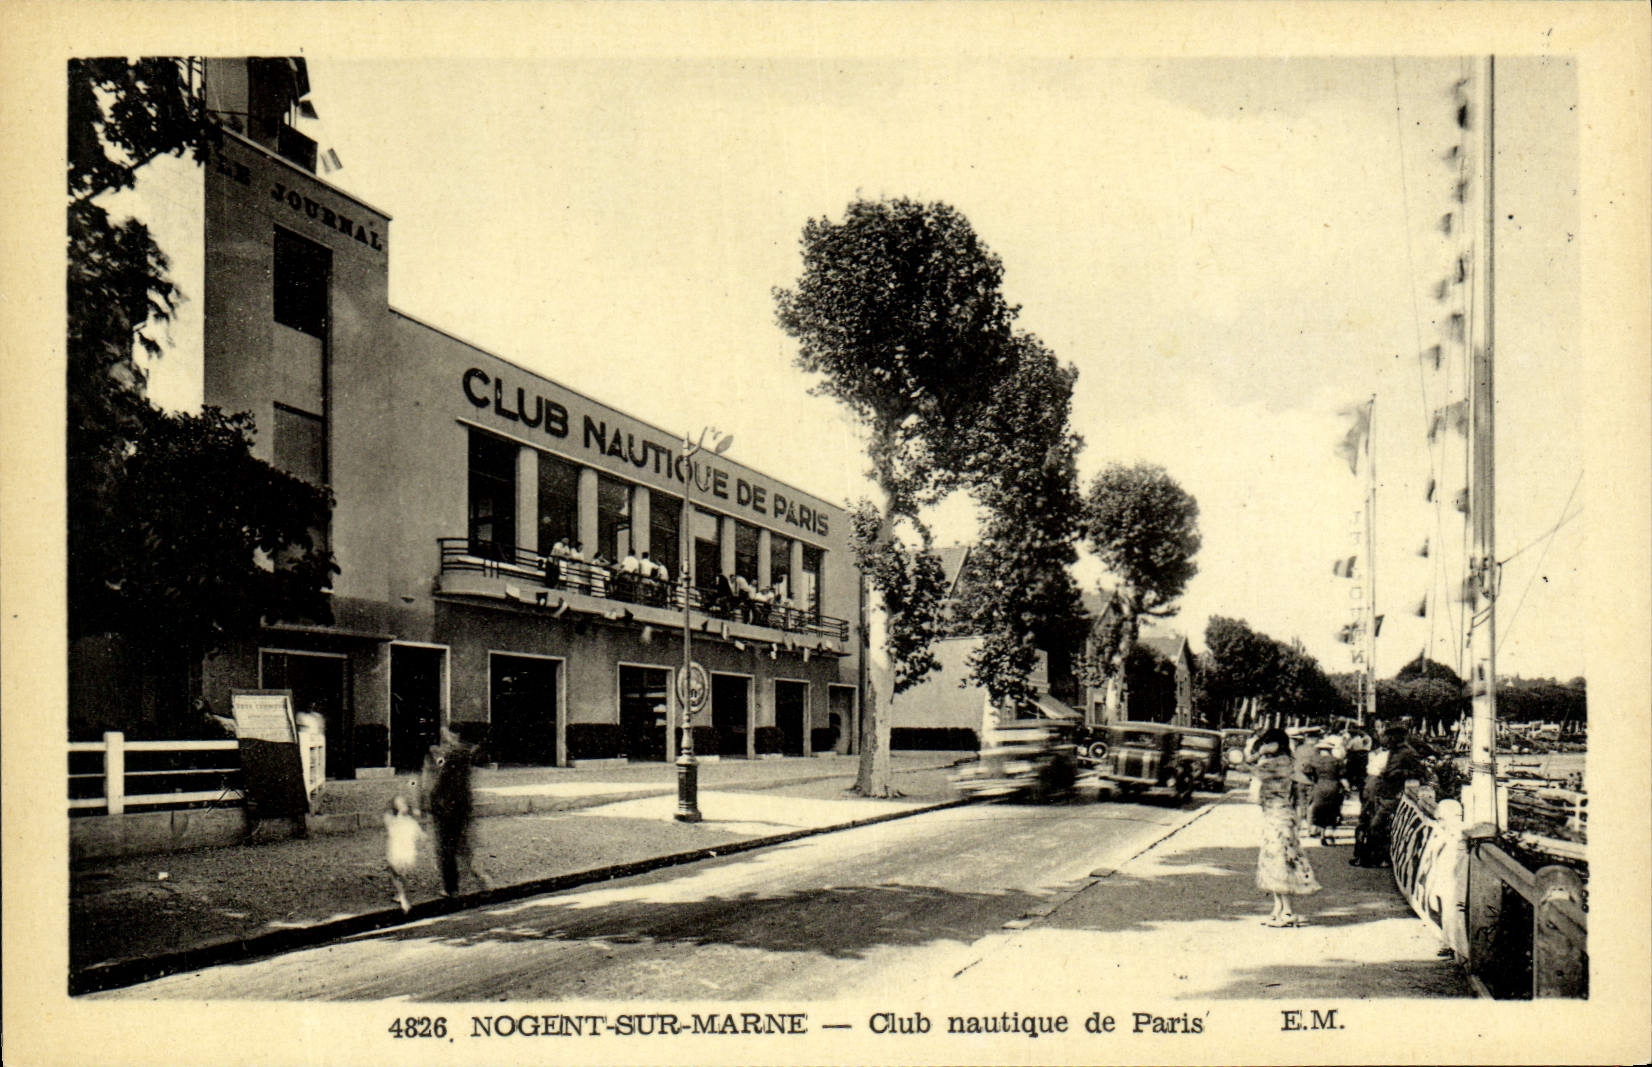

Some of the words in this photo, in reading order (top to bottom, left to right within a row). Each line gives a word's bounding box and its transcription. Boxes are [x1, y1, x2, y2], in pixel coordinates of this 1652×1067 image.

[271, 183, 383, 251] JOURNAL
[462, 367, 568, 438] CLUB
[583, 414, 729, 500] NAUTIQUE
[736, 478, 768, 515] DE
[773, 493, 830, 536] PARIS
